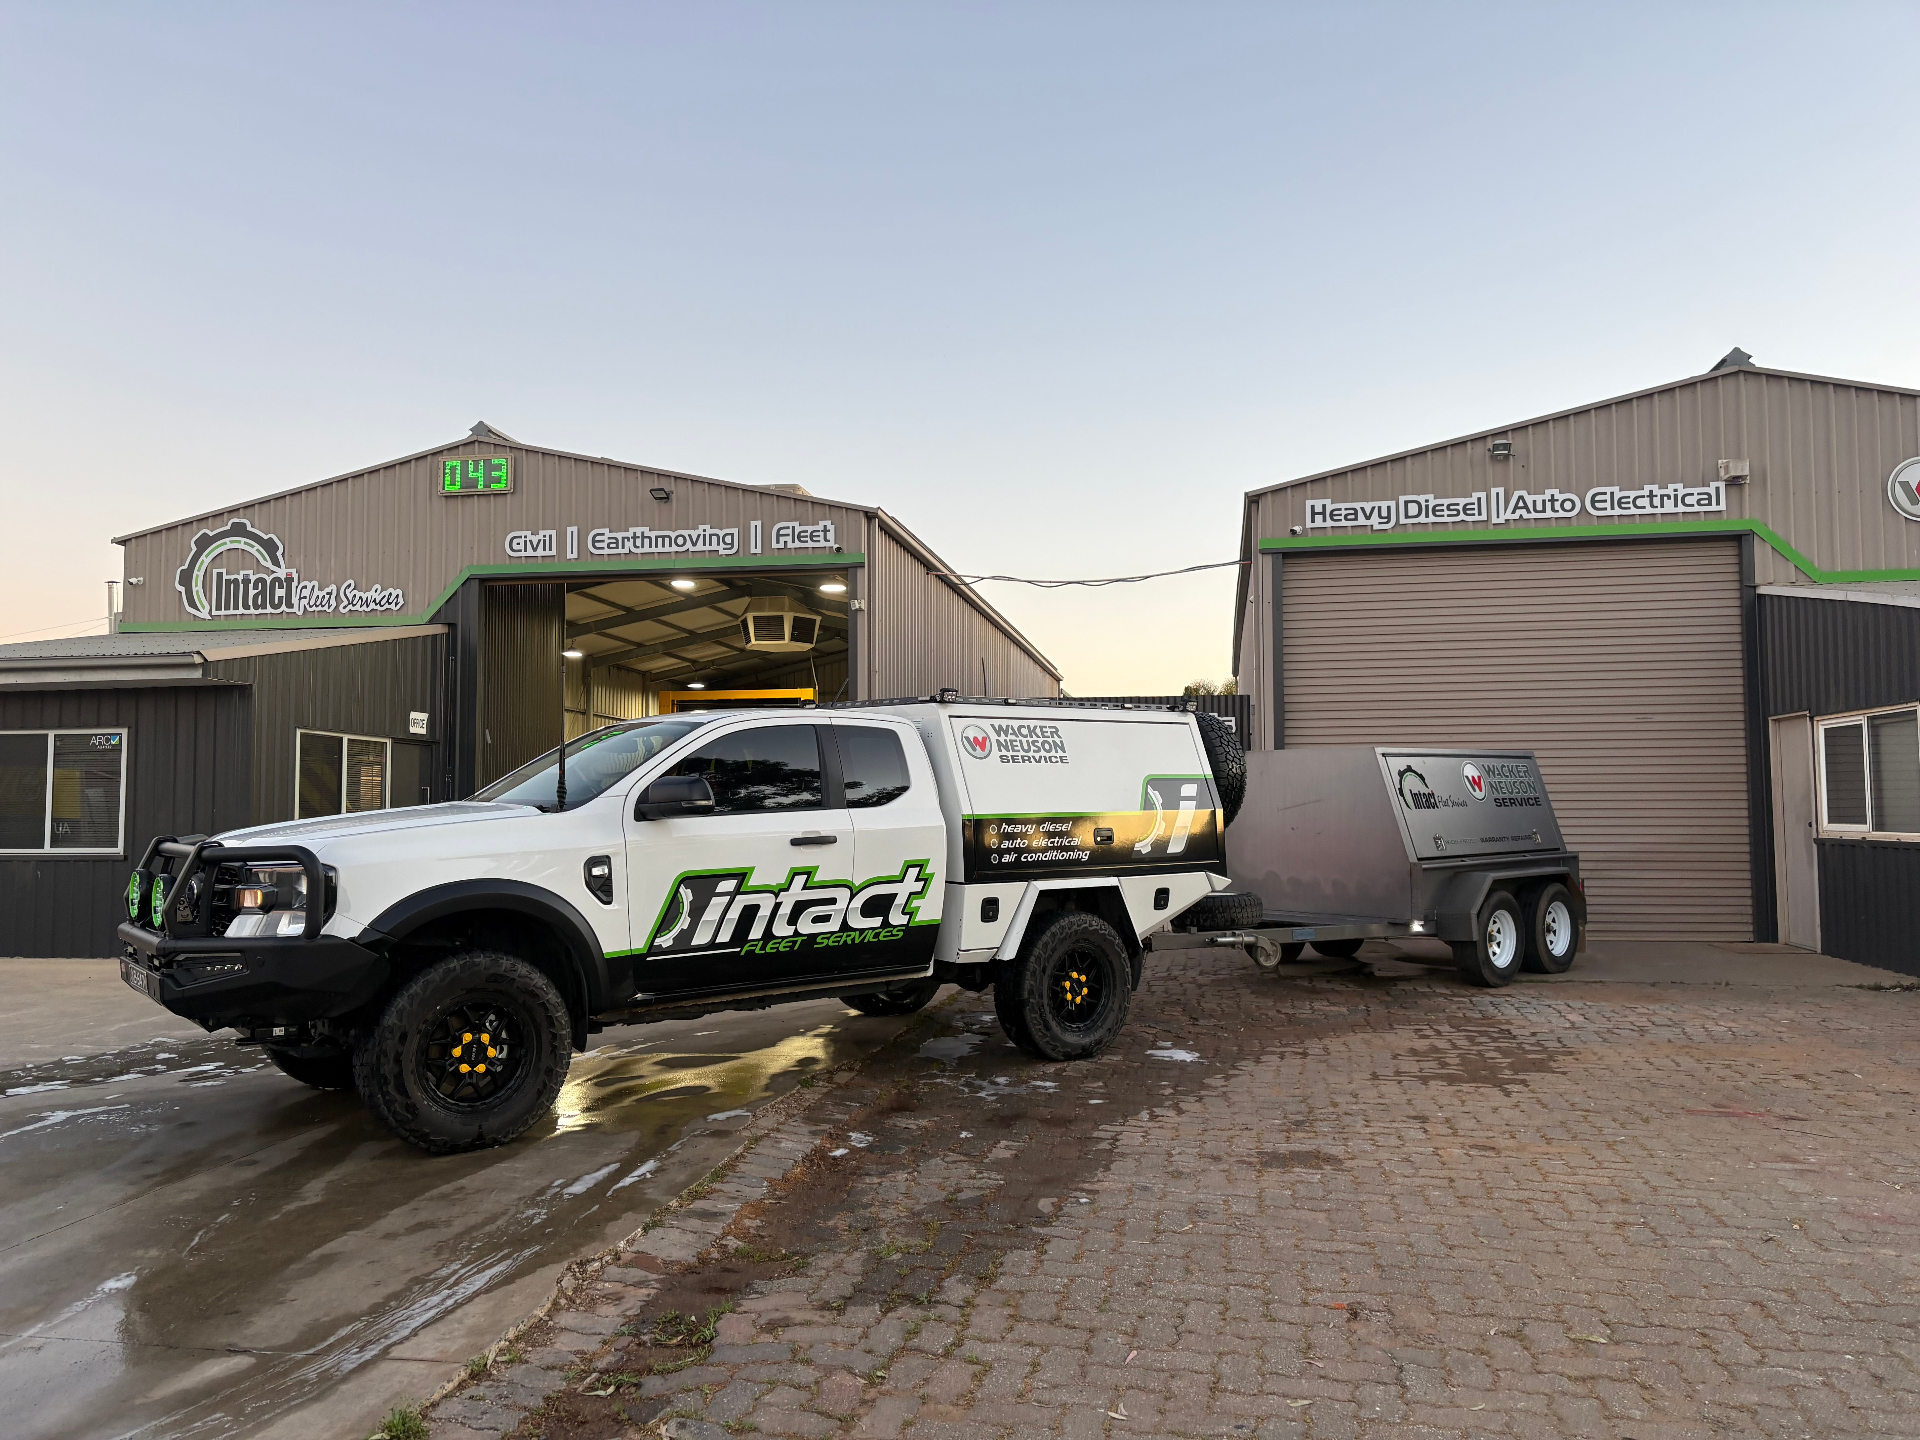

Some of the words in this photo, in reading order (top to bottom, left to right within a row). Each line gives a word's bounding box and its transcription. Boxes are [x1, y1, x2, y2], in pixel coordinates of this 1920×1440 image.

[445, 458, 506, 491] 043
[1309, 503, 1392, 525] Heavy
[1403, 496, 1483, 519] Diesel
[1510, 494, 1578, 515] Auto
[1589, 485, 1722, 511] Electrical
[508, 533, 553, 553] Civil
[591, 527, 736, 552] Earthmoving
[775, 524, 831, 545] Fleet
[214, 571, 295, 612] Intact
[297, 584, 334, 612] Fleet
[342, 581, 402, 610] Services
[990, 723, 1063, 739] WACKER
[89, 735, 111, 746] ARC
[995, 738, 1067, 754] NEUSON
[998, 754, 1070, 764] SERVICE
[1481, 763, 1534, 780] WACKER
[1487, 779, 1540, 797] NEUSON
[1409, 788, 1440, 810] Intact
[1494, 796, 1543, 808] SERVICE
[1000, 822, 1036, 835] heavy
[1039, 820, 1073, 833] diesel
[1000, 838, 1028, 849] auto
[1032, 835, 1083, 848] electrical
[1001, 851, 1018, 863] air
[1020, 849, 1090, 862] conditioning
[690, 867, 926, 946] intact
[740, 936, 808, 955] FLEET
[813, 926, 907, 948] SERVICES
